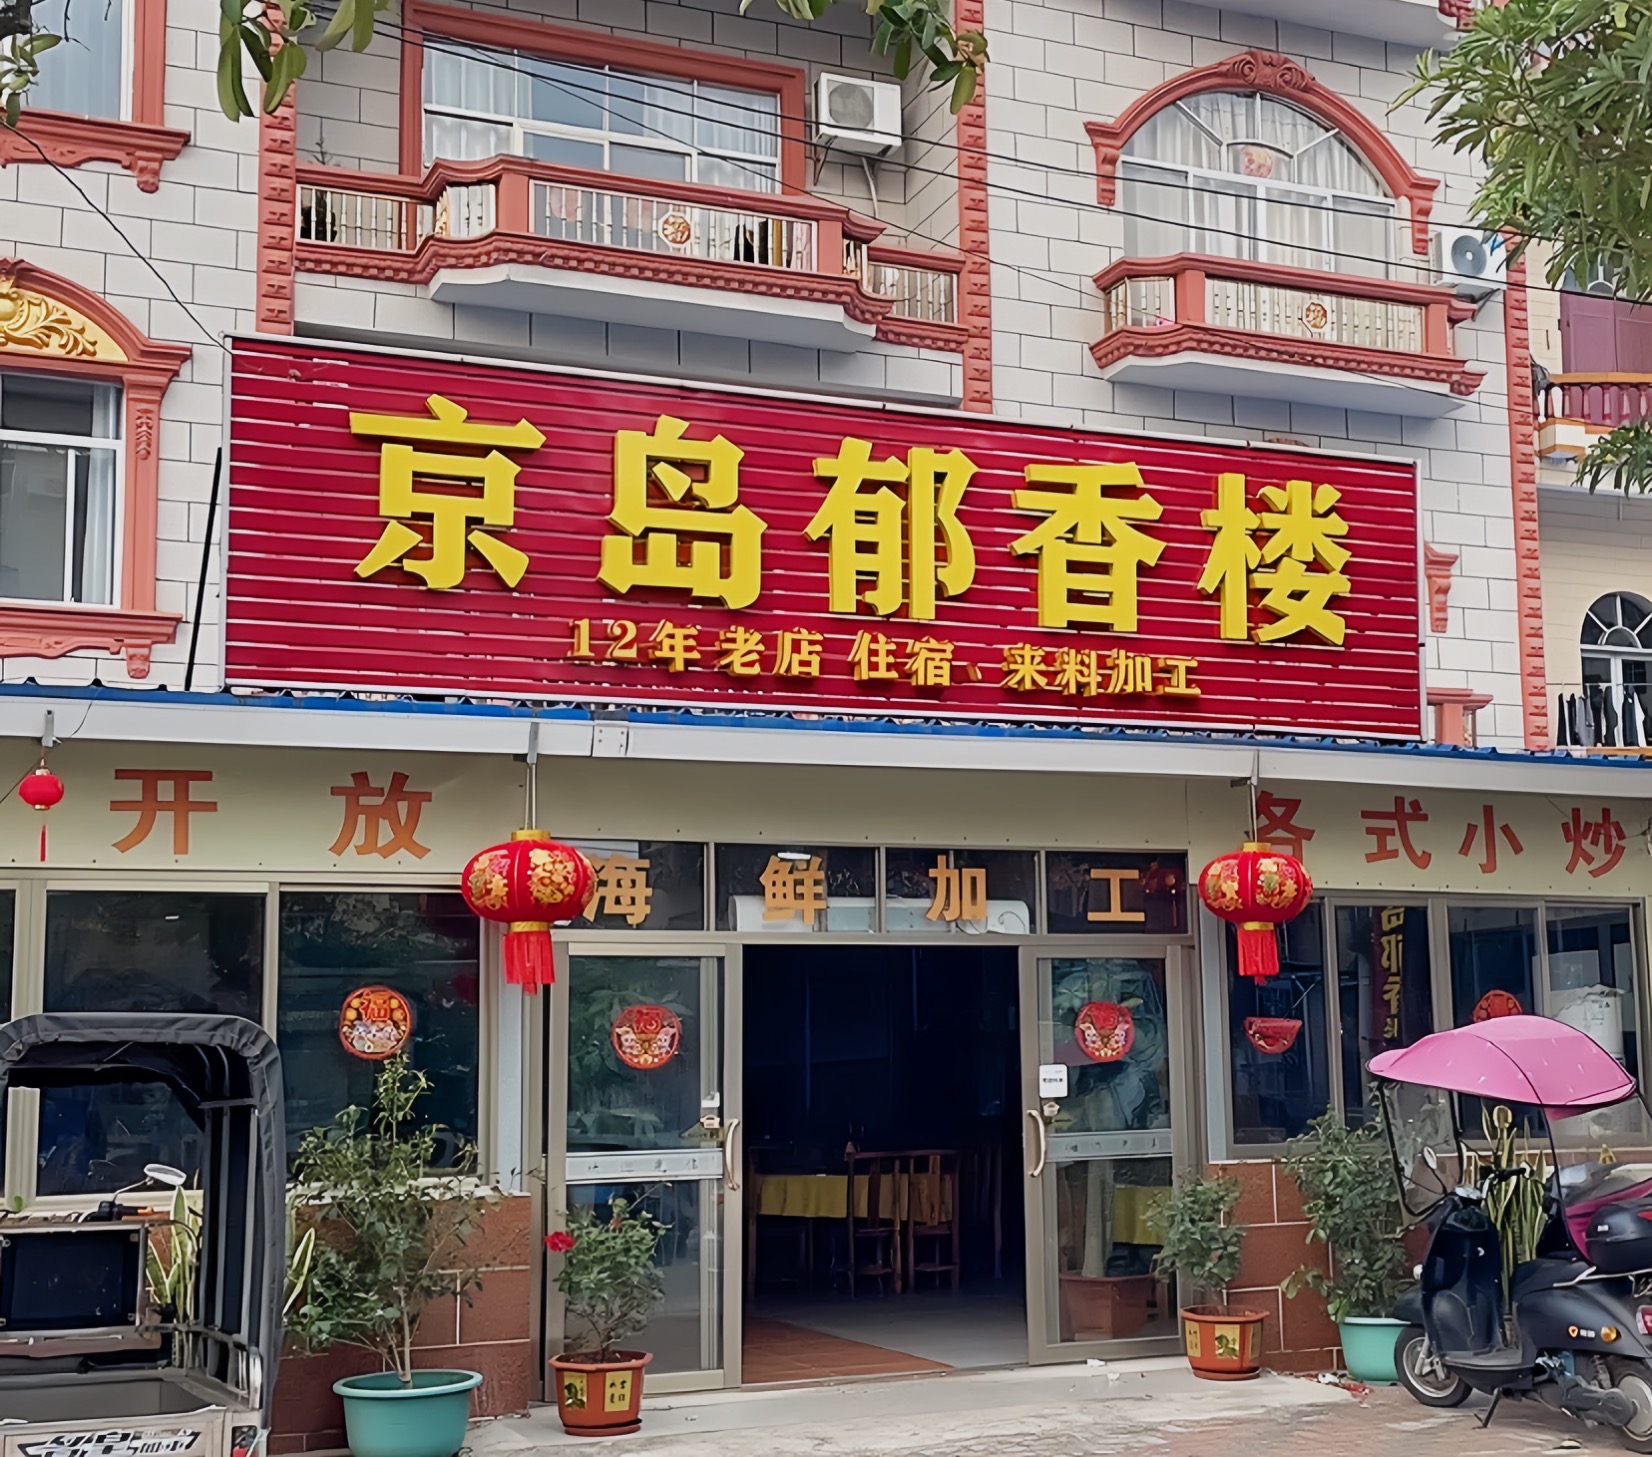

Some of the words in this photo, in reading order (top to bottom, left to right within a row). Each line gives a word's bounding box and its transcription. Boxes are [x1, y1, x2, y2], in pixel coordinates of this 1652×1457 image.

[350, 393, 1352, 646] 京岛郁香楼
[110, 768, 432, 860] 开放
[1245, 790, 1626, 878] 各式小炒
[584, 854, 1146, 926] 海鲜加工
